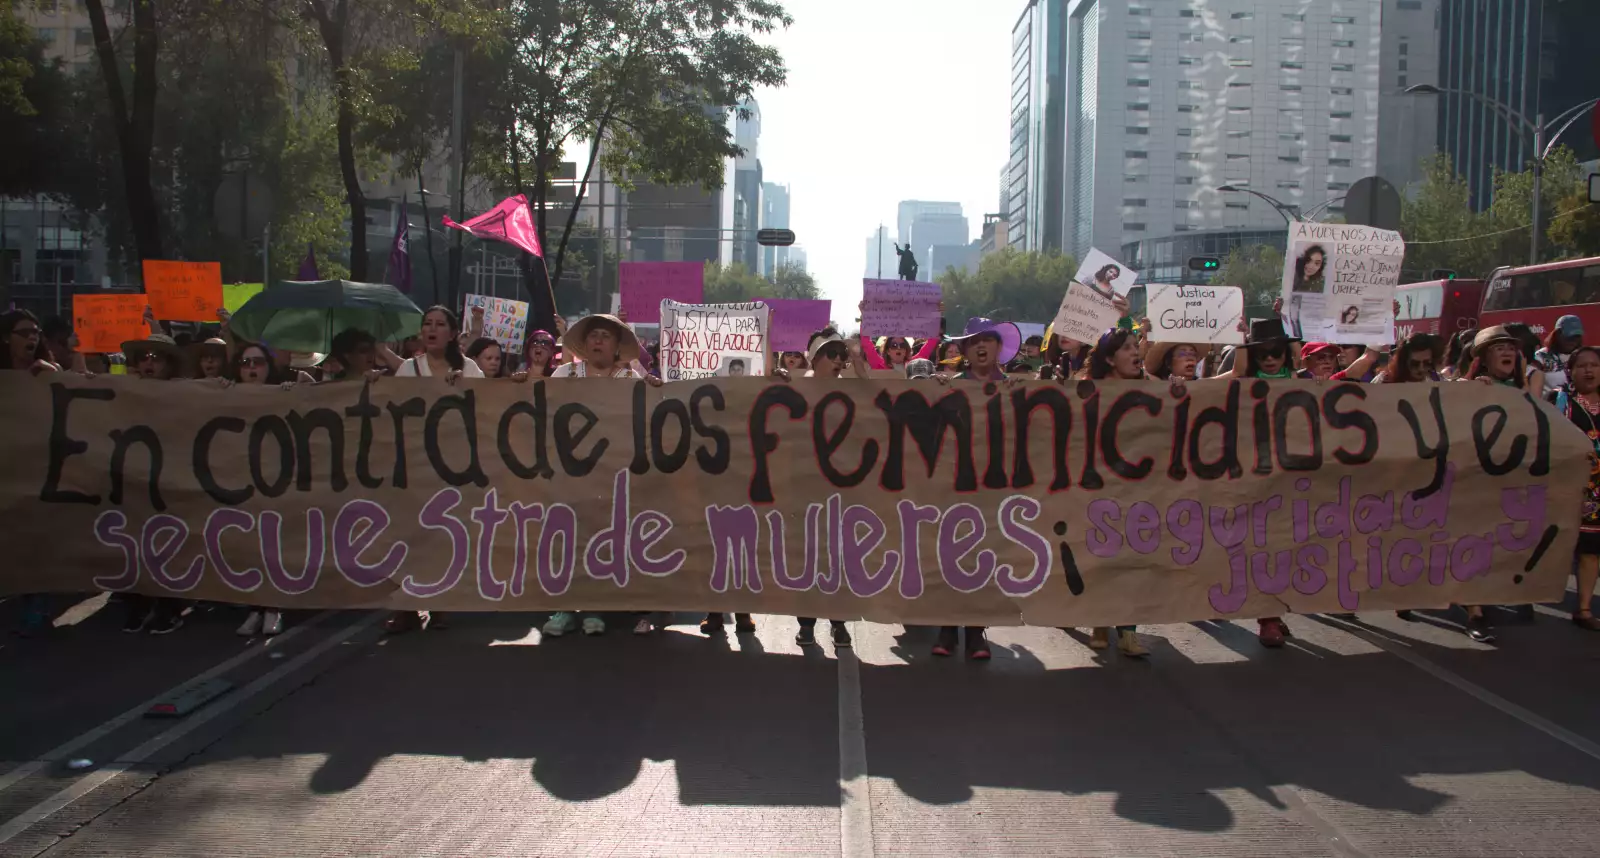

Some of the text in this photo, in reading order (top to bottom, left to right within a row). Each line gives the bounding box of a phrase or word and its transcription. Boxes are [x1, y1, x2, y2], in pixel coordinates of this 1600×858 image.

[1297, 224, 1367, 242] AYUDENOS
[1336, 242, 1389, 256] REGRESE
[1335, 257, 1366, 272] CASA
[1333, 271, 1368, 284] ITZEL
[1176, 284, 1216, 298] Justicia
[1185, 300, 1202, 309] para
[664, 309, 732, 333] JUSTICIA
[736, 316, 761, 333] PARA
[1160, 308, 1218, 330] Gabriela
[661, 330, 700, 349] DIANA
[704, 332, 764, 353] VELAZQUEZ
[1393, 324, 1414, 342] DMX
[41, 379, 1550, 512] En contra de los feminicidios y el
[583, 467, 687, 588] de
